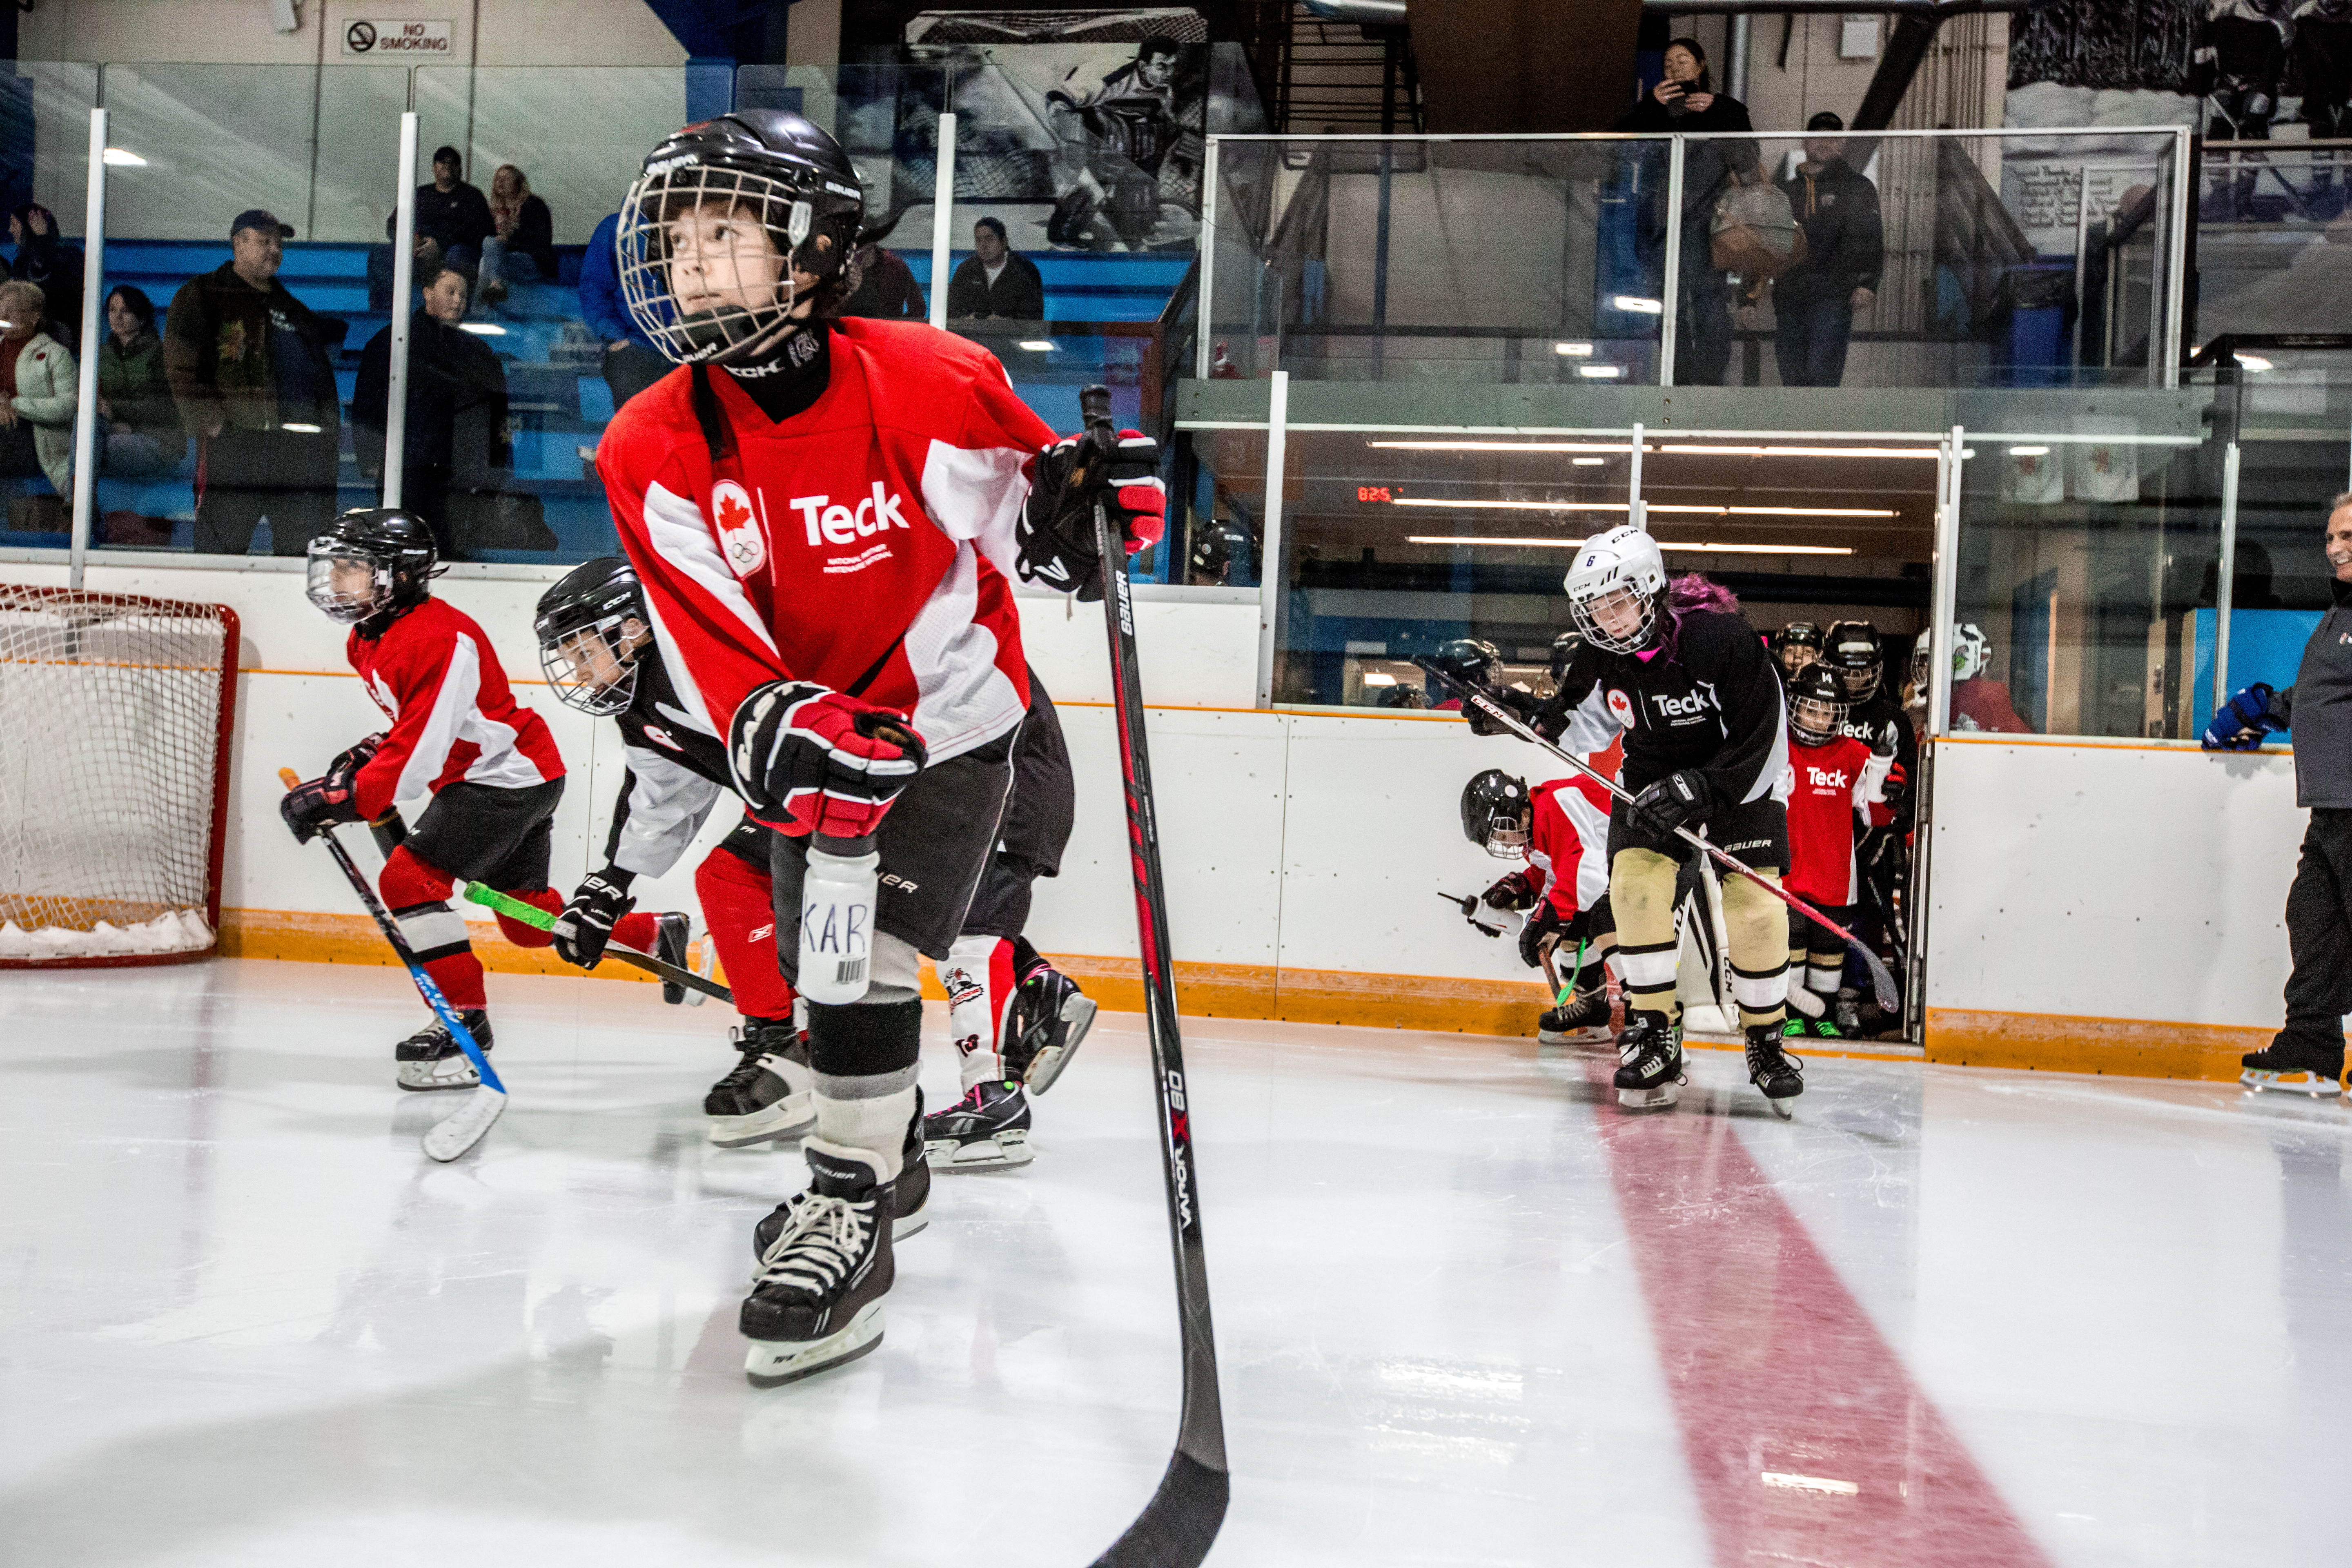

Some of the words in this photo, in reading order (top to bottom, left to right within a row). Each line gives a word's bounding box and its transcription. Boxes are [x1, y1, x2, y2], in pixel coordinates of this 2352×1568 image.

[404, 23, 425, 36] NO
[380, 37, 448, 50] SMOKING
[790, 481, 911, 546] Teck
[1611, 529, 1638, 544] CCM
[1586, 556, 1596, 567] 6
[1573, 582, 1590, 592] CCM
[1116, 570, 1133, 636] BAUER
[1822, 672, 1832, 684] 14
[1472, 698, 1503, 718] CCM
[1651, 689, 1710, 716] Teck
[1807, 766, 1848, 788] Teck
[1724, 840, 1772, 853] BAUER
[1724, 956, 1733, 993] CCM
[1174, 1144, 1192, 1229] VAPOR
